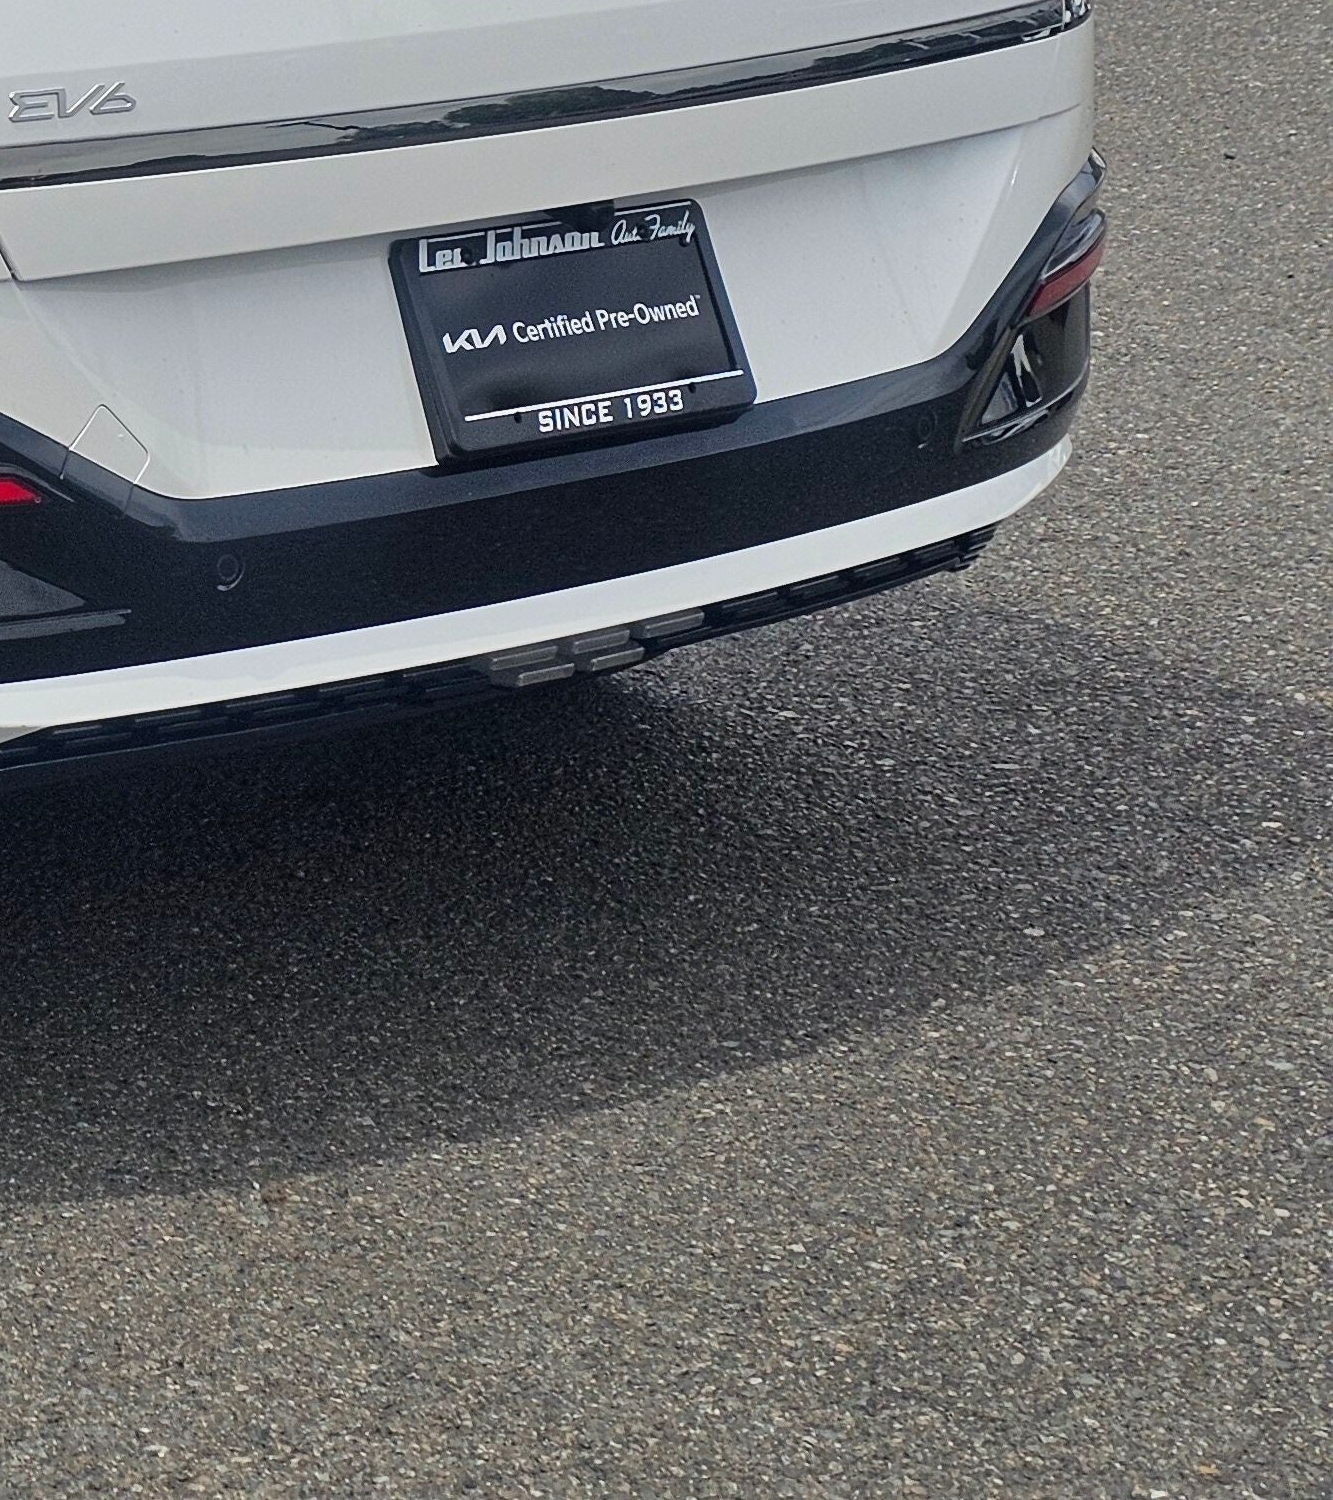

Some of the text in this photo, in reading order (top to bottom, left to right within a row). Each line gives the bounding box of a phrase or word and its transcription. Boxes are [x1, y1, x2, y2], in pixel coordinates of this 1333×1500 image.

[8, 80, 138, 123] EV6
[479, 222, 606, 265] Johnson
[611, 219, 646, 246] Aut
[644, 209, 696, 243] Family
[442, 324, 507, 354] KIA
[512, 310, 596, 344] Certified
[538, 389, 685, 434] SINCE 1933
